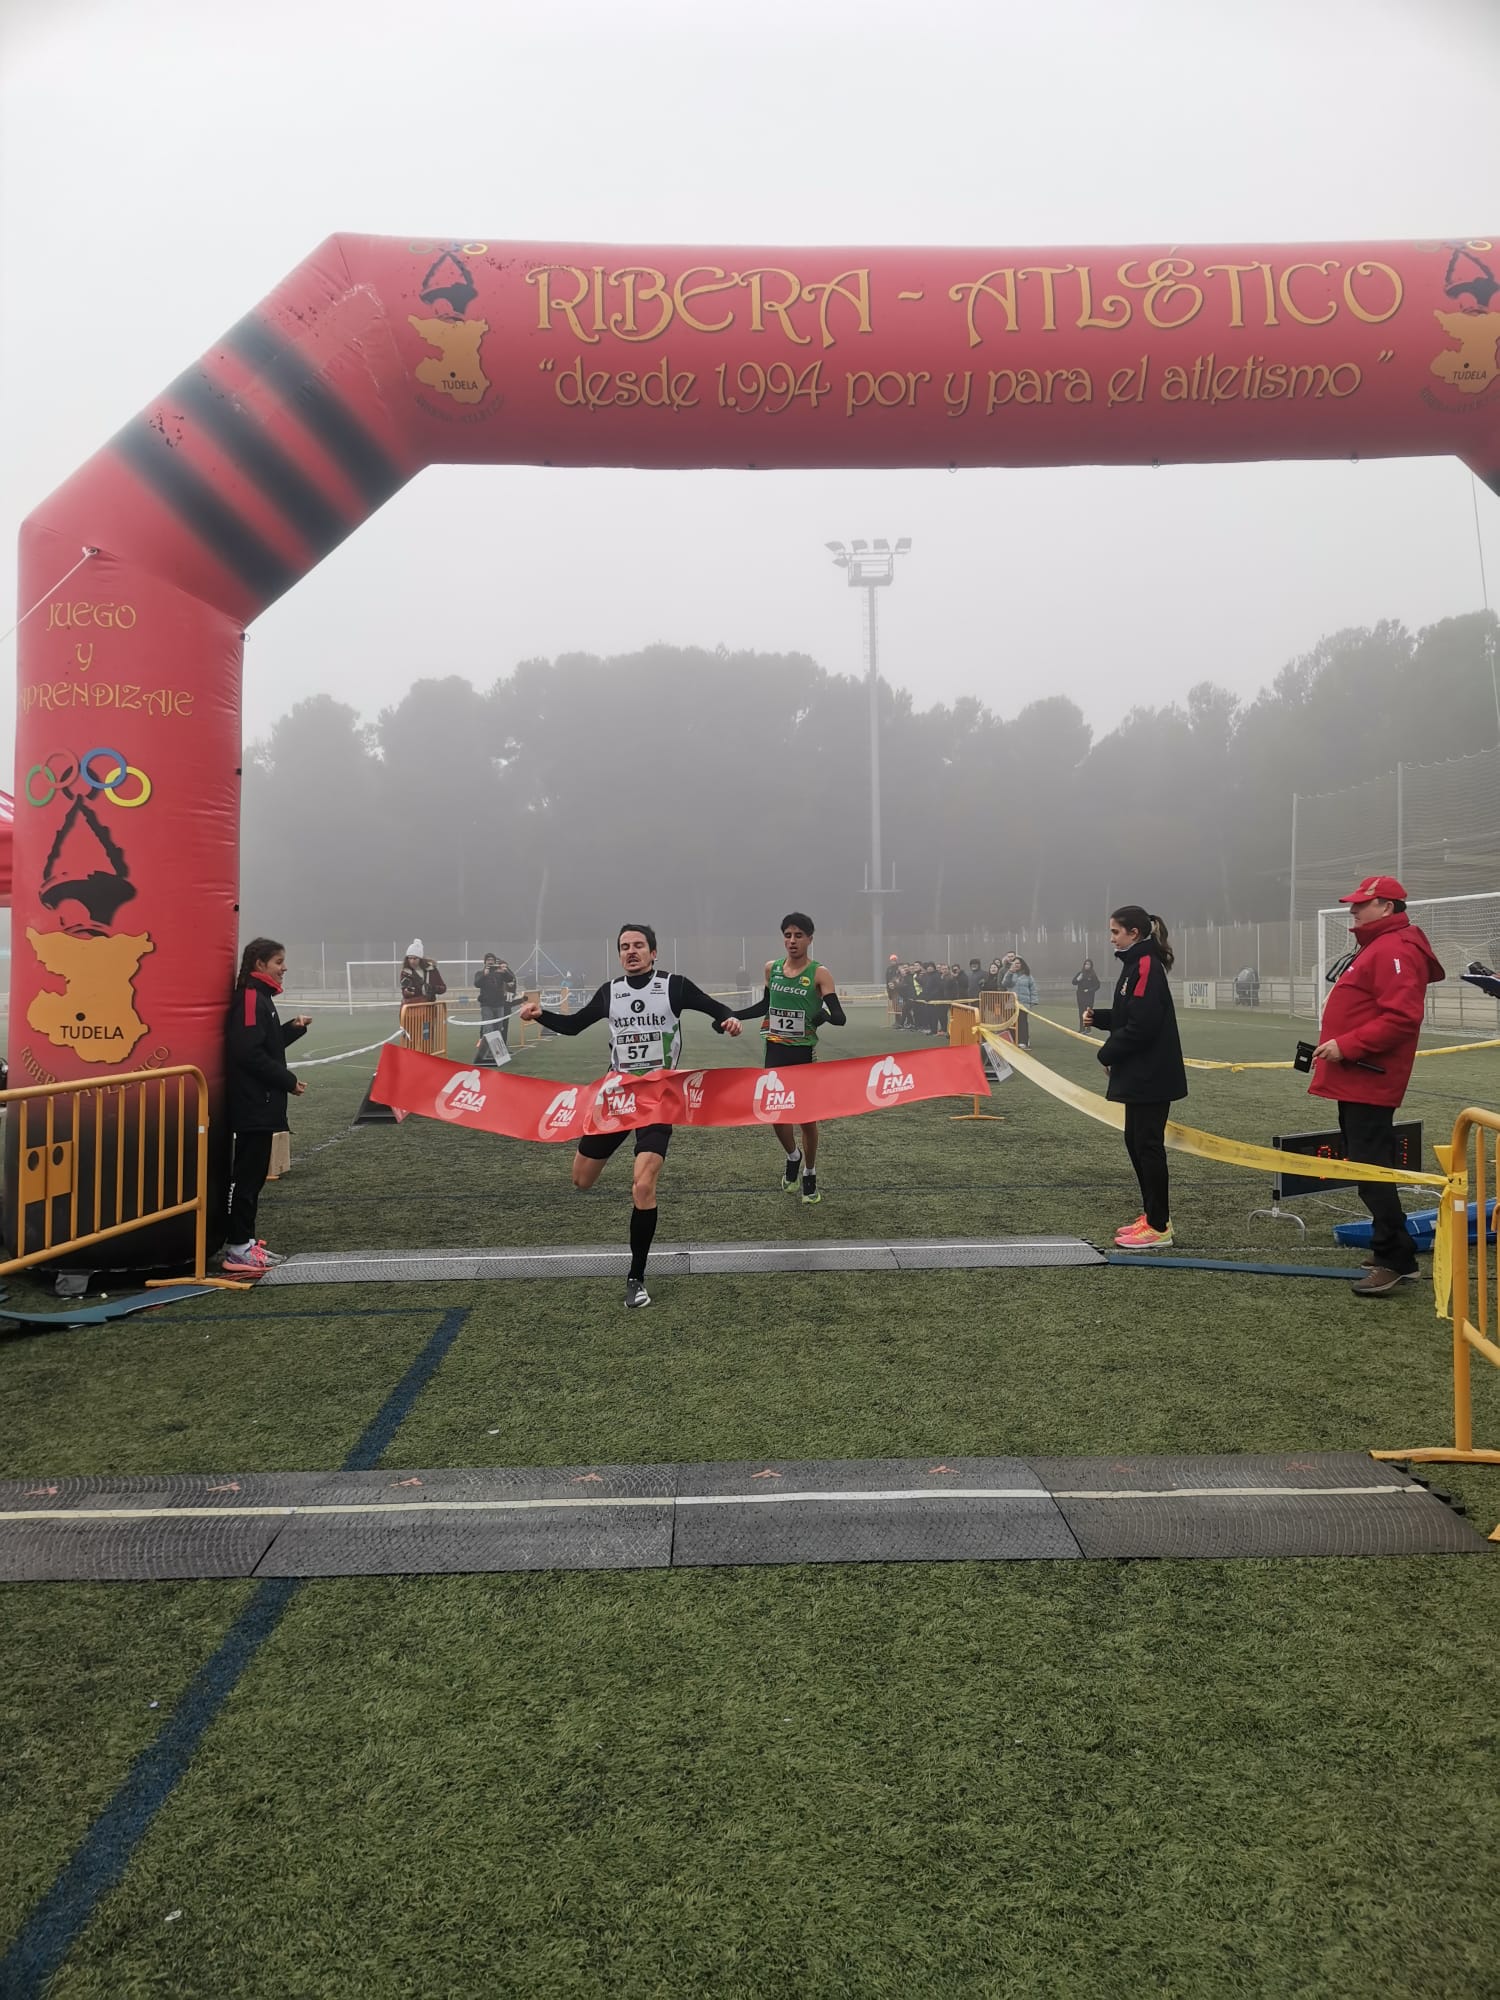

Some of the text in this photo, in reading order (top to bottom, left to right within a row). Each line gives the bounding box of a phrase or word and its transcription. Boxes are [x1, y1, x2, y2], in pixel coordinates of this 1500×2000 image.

[525, 265, 873, 348] RIBERA
[948, 247, 1403, 348] ATLÉTICO
[1453, 370, 1487, 380] TUDELA
[441, 380, 479, 390] TUDELA
[715, 360, 831, 413] 1.994
[846, 371, 931, 417] por
[943, 368, 972, 417] y
[985, 367, 1094, 415] para
[1107, 354, 1149, 408] el
[46, 601, 136, 631] JUEGO
[770, 982, 808, 996] Huesca
[778, 1018, 794, 1030] 12
[60, 1025, 124, 1040] TUDELA
[627, 1044, 649, 1060] 57
[20, 1046, 66, 1093] RIBER
[883, 1073, 914, 1090] FNA
[454, 1090, 487, 1108] FNA
[607, 1092, 636, 1110] FNA
[766, 1091, 795, 1105] FNA
[553, 1109, 577, 1122] FNA
